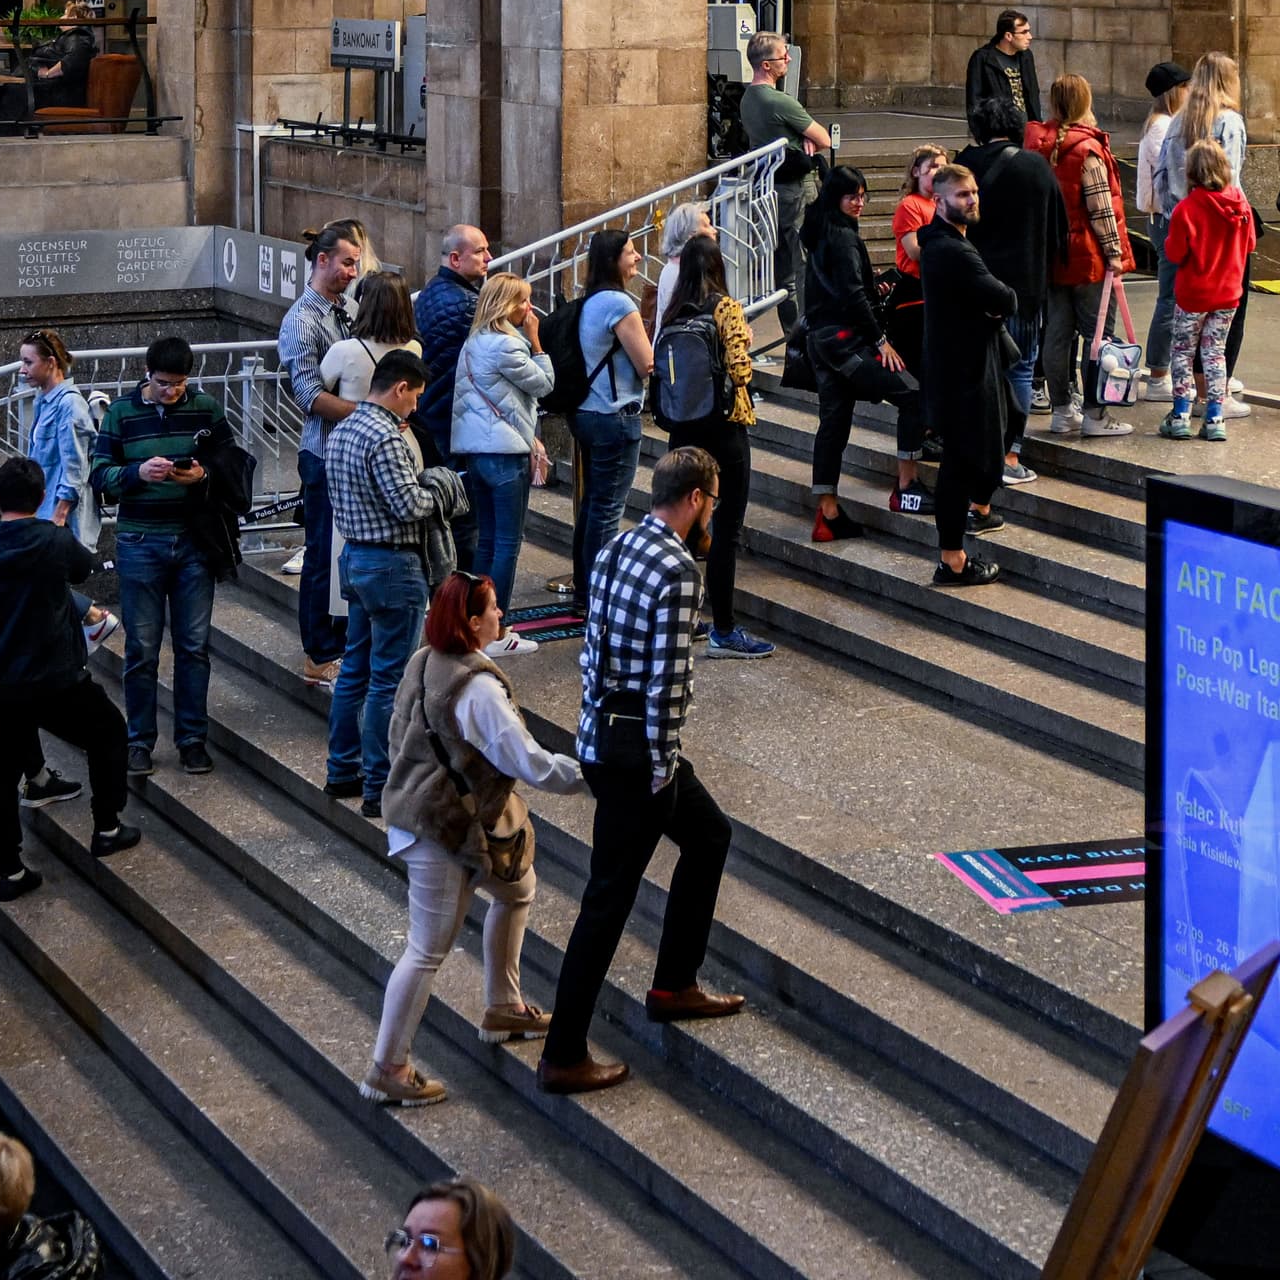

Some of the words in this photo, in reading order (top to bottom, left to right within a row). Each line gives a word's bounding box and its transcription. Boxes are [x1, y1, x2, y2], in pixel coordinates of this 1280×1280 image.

[342, 32, 381, 48] BANKOMAT
[19, 239, 88, 252] ASCENSEUR
[117, 237, 166, 248] AUFZUG
[19, 252, 81, 263] TOILETTES
[18, 264, 77, 276] VESTIAIRE
[282, 263, 296, 285] WC
[18, 277, 56, 288] POSTE
[118, 273, 146, 284] POST
[277, 498, 304, 512] Kultury
[901, 493, 922, 511] RED
[1177, 561, 1226, 604] ART
[1177, 624, 1207, 656] The
[1213, 637, 1243, 672] Pop
[1177, 663, 1251, 711] Post-War
[1017, 853, 1081, 864] KASA
[1086, 847, 1145, 858] BILET
[1059, 884, 1122, 896] DESK
[1176, 920, 1204, 944] 2709
